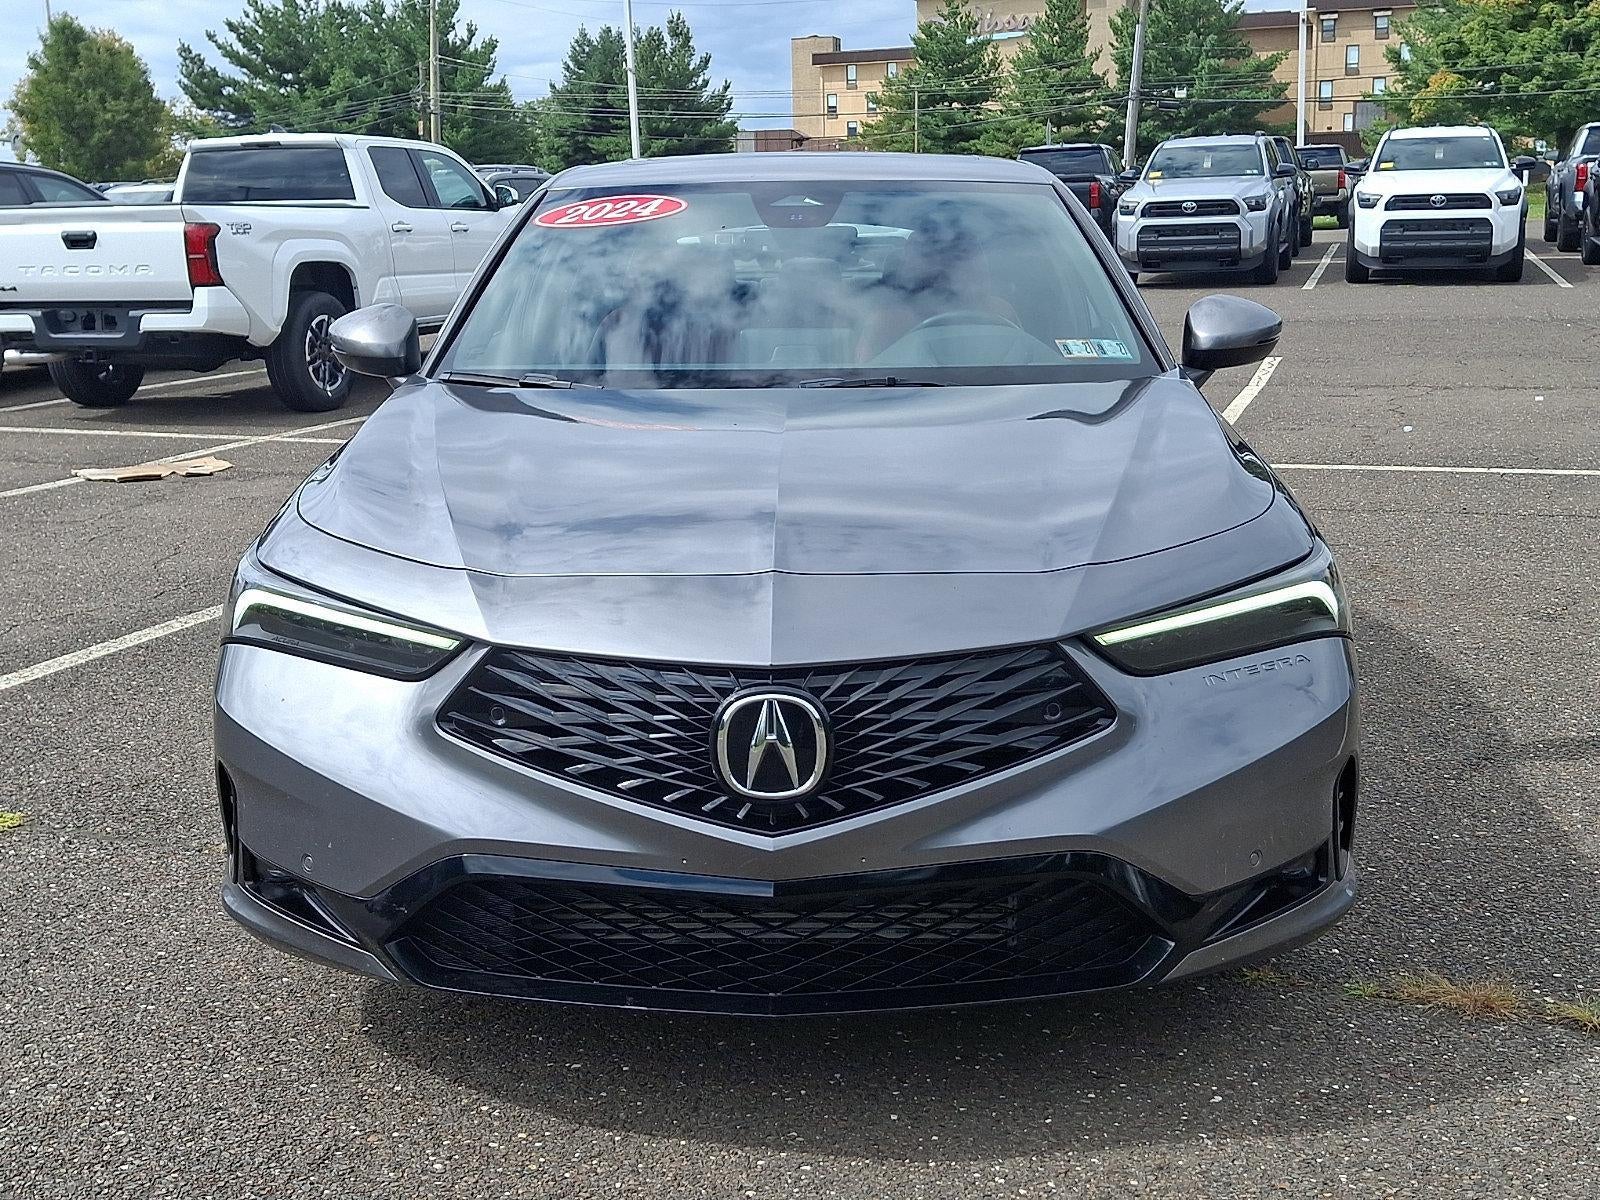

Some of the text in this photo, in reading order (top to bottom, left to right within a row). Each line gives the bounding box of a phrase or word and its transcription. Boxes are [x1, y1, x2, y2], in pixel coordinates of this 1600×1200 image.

[555, 199, 664, 225] 2024
[18, 264, 153, 276] TACOMA
[1202, 654, 1311, 687] INTEGRA
